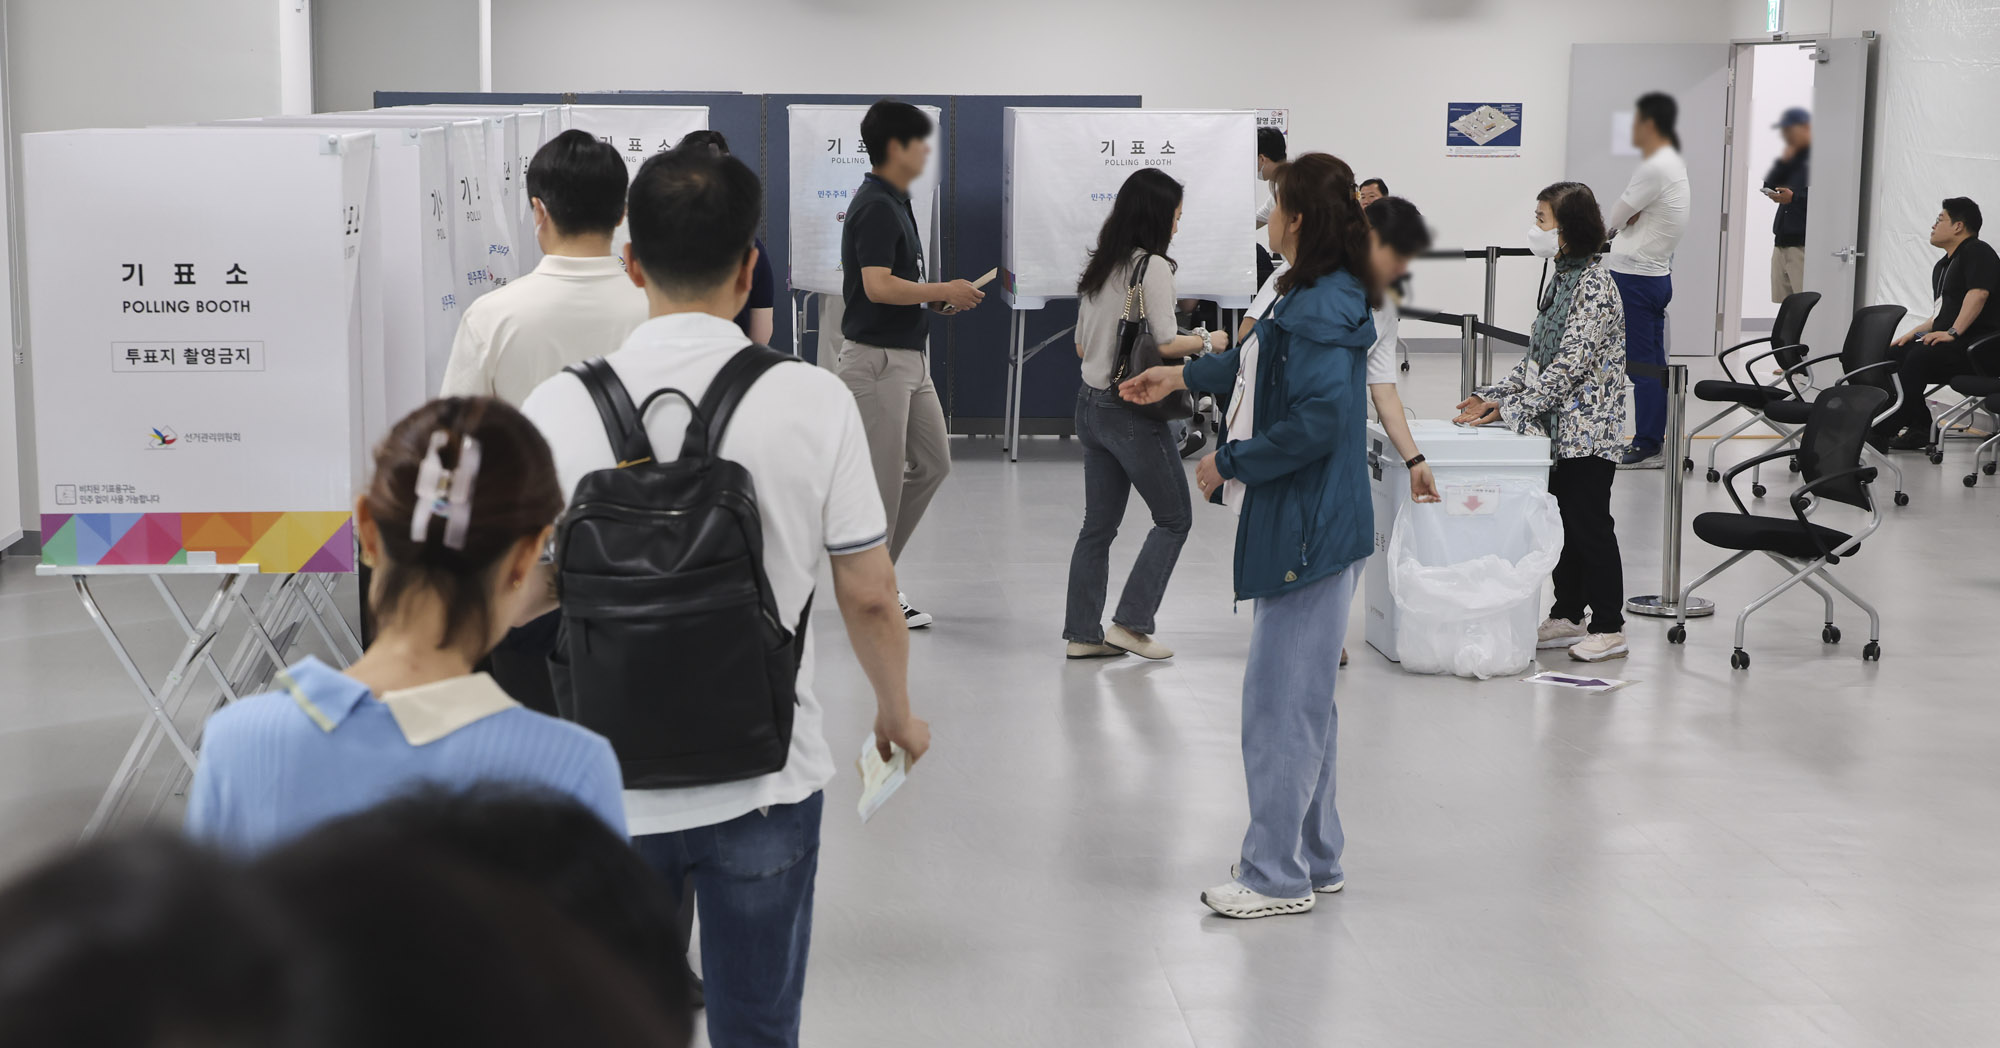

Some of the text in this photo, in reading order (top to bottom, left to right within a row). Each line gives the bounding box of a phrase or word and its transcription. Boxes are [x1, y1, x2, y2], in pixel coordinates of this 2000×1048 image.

[817, 190, 847, 198] 민주주의
[123, 300, 251, 314] POLLING BOOTH
[125, 347, 250, 365] 투표지 촬영금지
[184, 432, 241, 443] 선거관리위원회
[110, 495, 124, 504] 사용
[125, 494, 160, 504] 가능합니다
